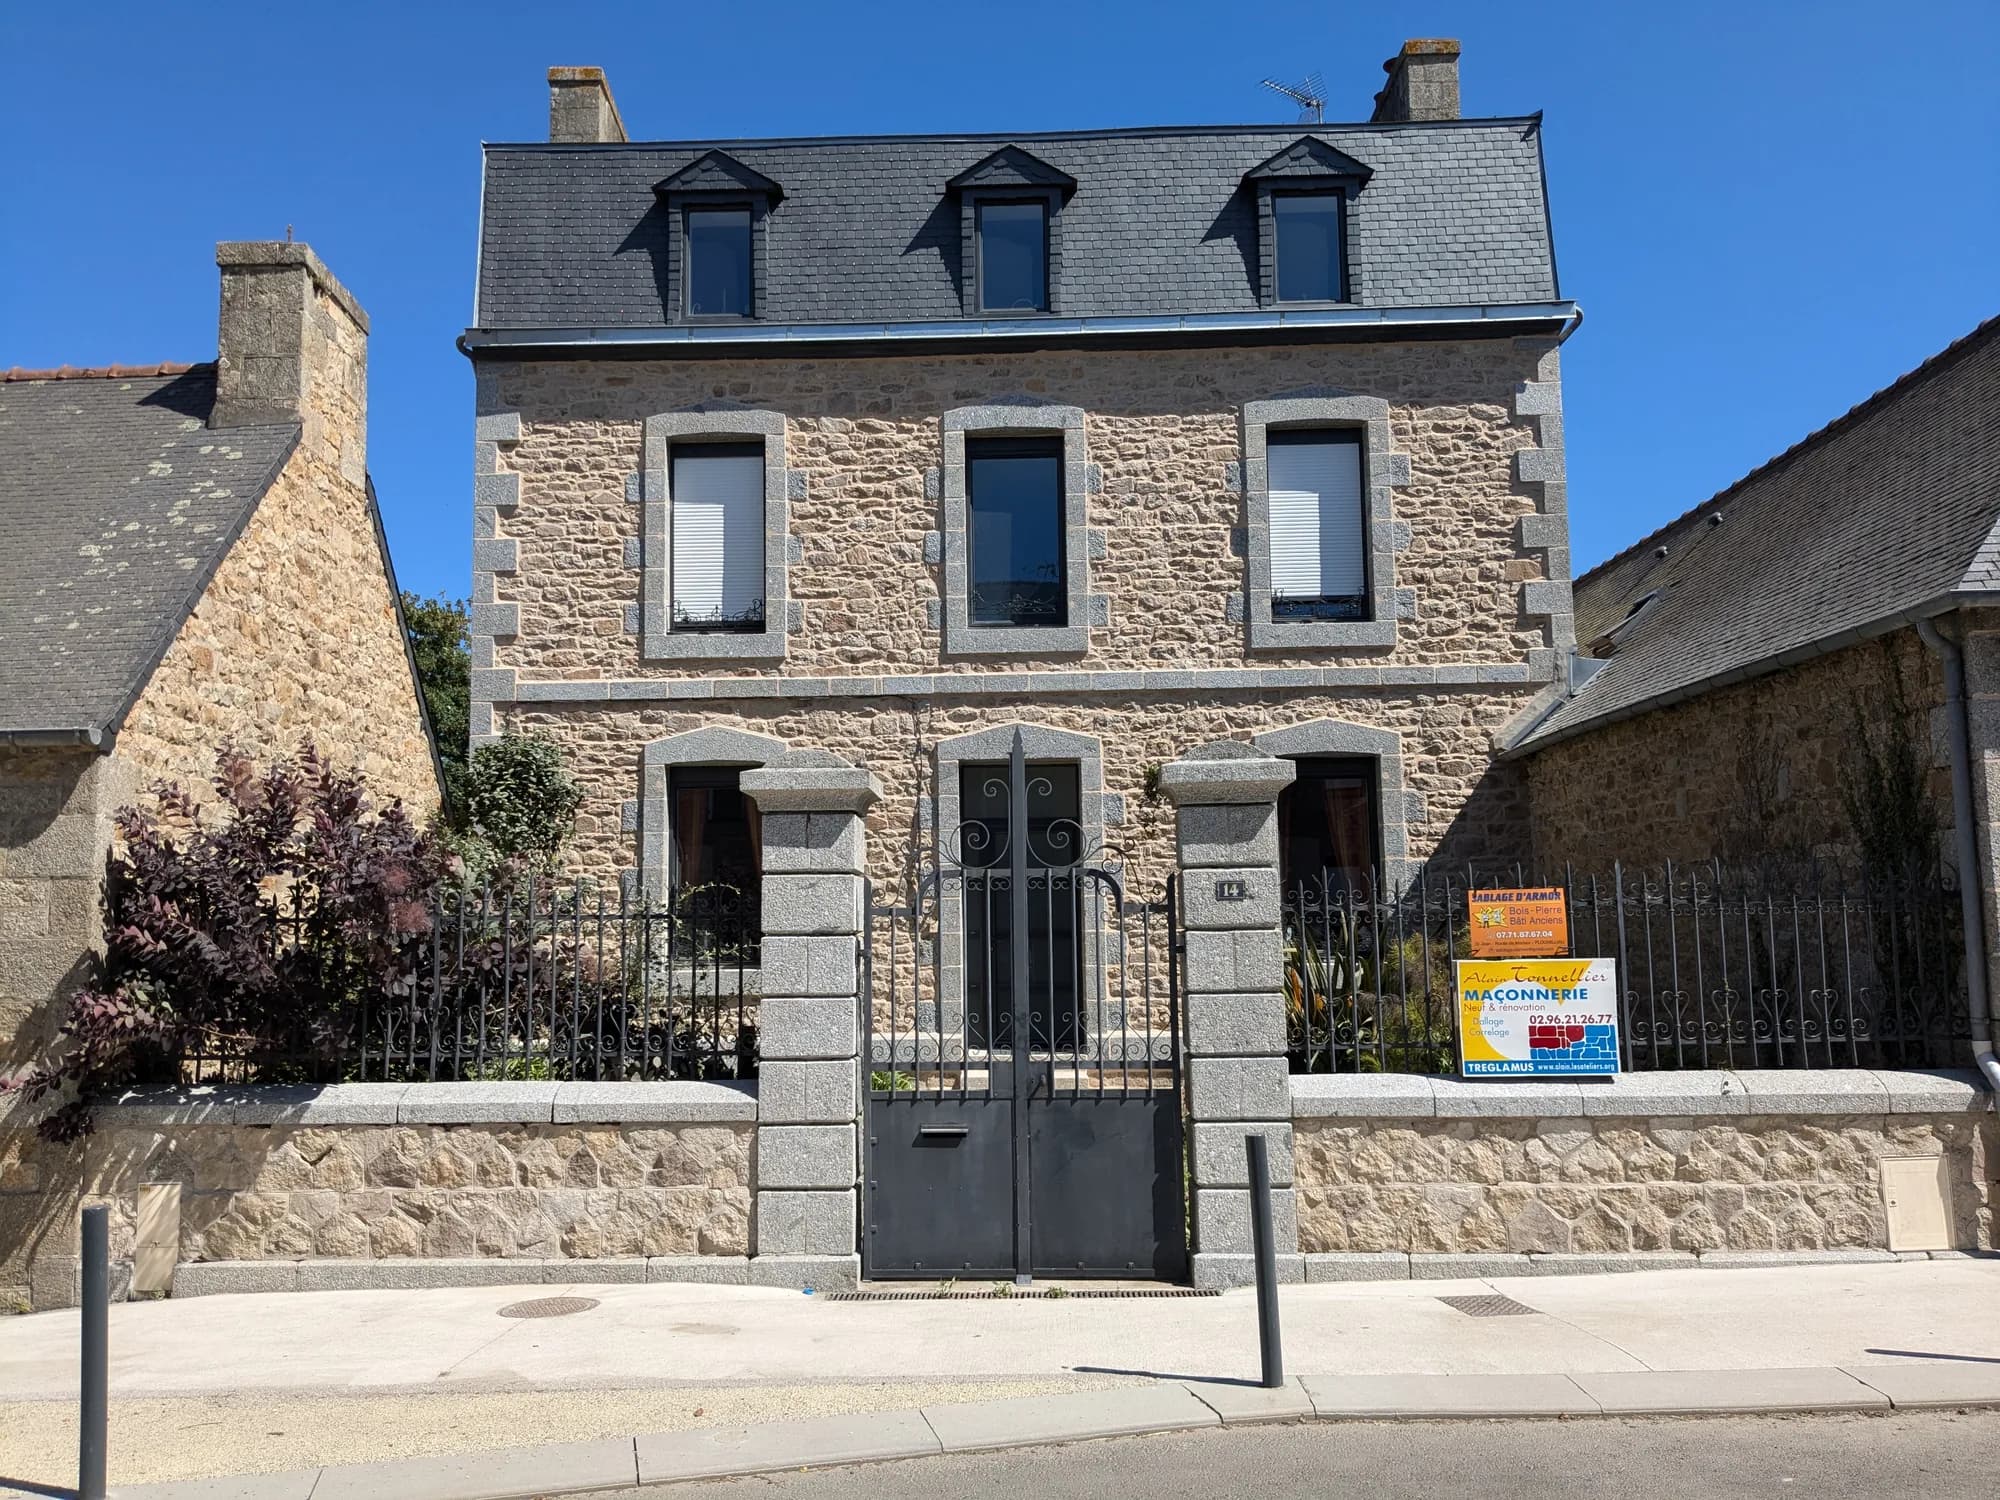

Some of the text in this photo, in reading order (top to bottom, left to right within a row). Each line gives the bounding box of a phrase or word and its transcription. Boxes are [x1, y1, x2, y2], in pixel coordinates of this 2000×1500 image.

[1224, 884, 1239, 896] 14
[1516, 892, 1561, 901] D'ARMOR
[1509, 906, 1529, 915] Bois
[1535, 905, 1562, 914] Pierre
[1510, 915, 1563, 925] Bâti Anciens
[1464, 966, 1609, 984] Alain Tonnellier
[1464, 988, 1588, 1004] MAÇONNERIE
[1464, 1002, 1546, 1012] Neuf & rénovation
[1472, 1016, 1504, 1027] Dallage
[1529, 1014, 1613, 1024] 02.96.21.26.77
[1469, 1027, 1510, 1038] Carrelage
[1468, 1063, 1534, 1072] TREGLAMUS
